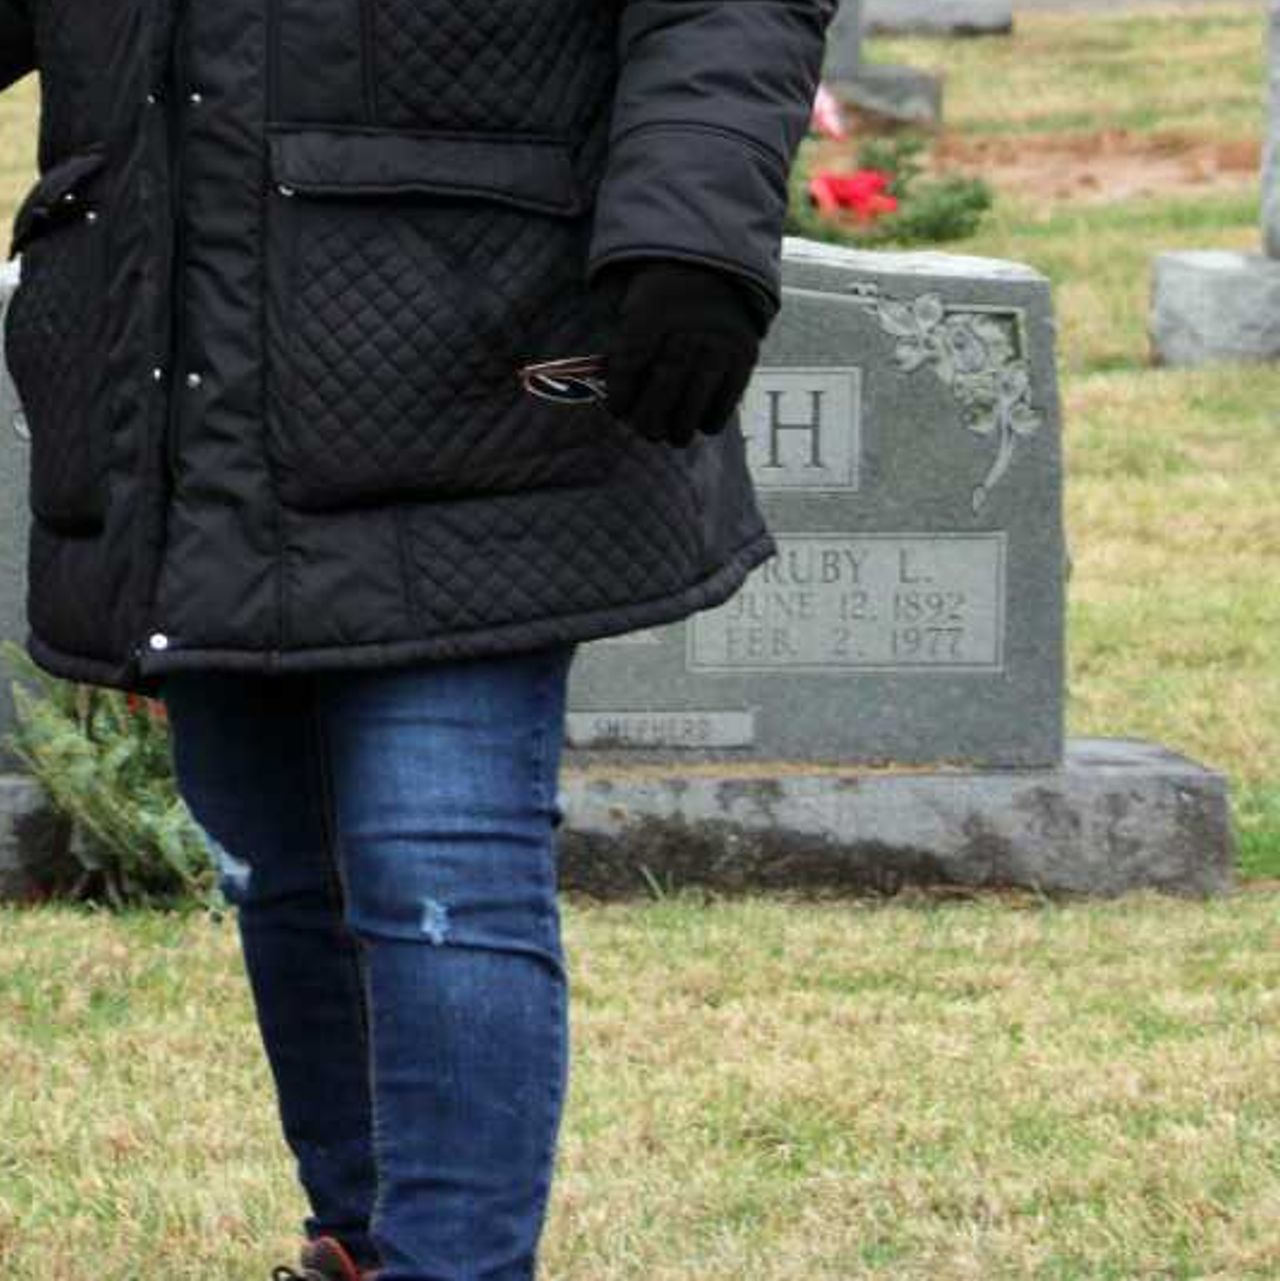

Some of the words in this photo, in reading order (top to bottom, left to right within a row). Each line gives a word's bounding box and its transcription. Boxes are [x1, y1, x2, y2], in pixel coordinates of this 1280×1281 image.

[762, 549, 870, 584] RUBY
[899, 549, 935, 584] L.
[726, 592, 814, 621] JUNE
[893, 592, 966, 621] 1892
[891, 625, 966, 658] 1977
